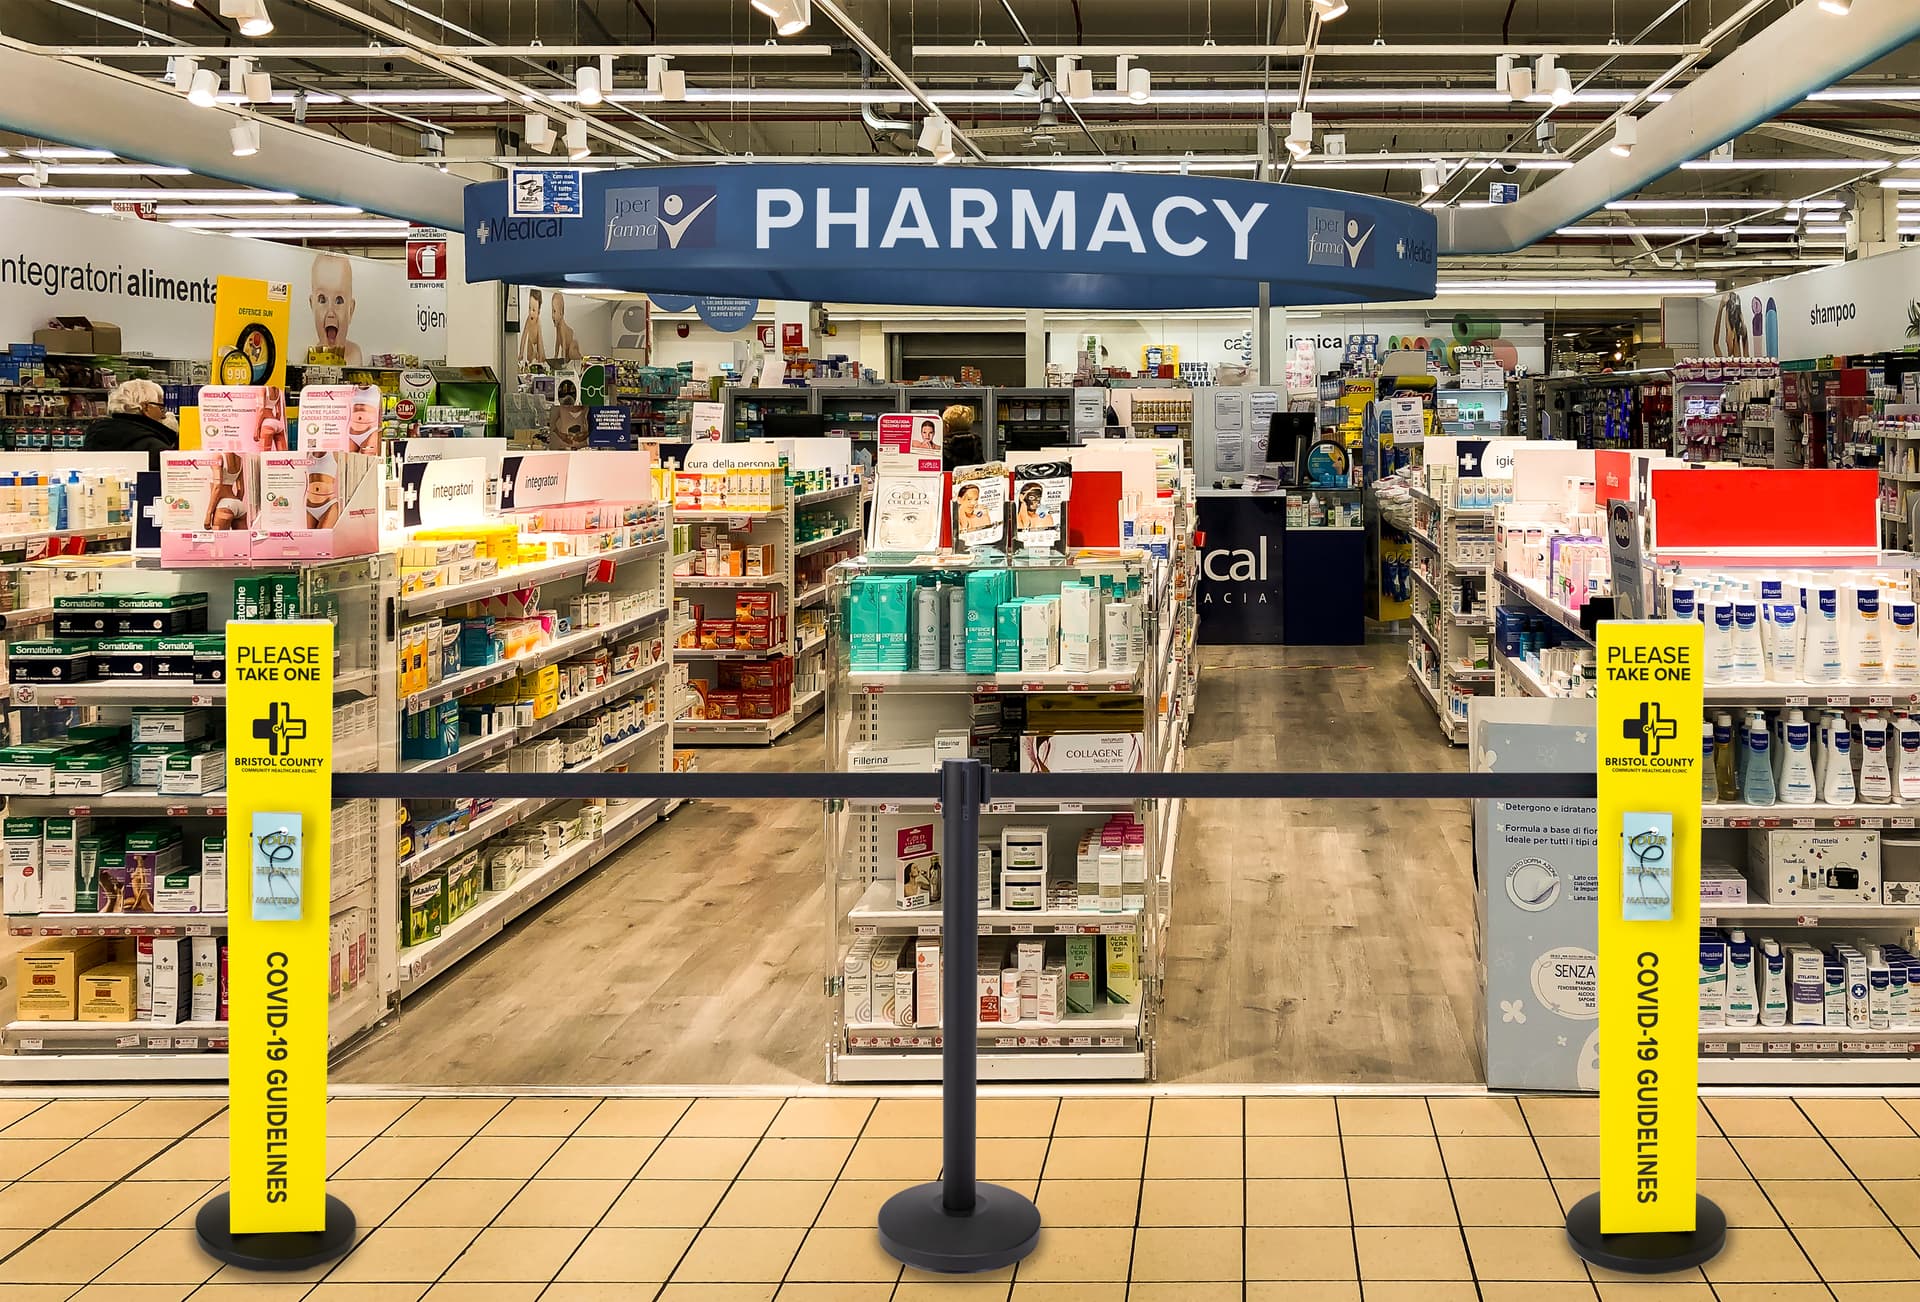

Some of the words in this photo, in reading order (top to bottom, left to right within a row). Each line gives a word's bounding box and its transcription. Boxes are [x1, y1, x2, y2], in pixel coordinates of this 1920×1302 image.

[616, 197, 650, 217] Iper
[490, 216, 564, 243] Medical
[756, 187, 1269, 261] PHARMACY
[1314, 217, 1338, 237] Iper
[604, 215, 657, 251] farma
[1307, 231, 1344, 265] farma
[1404, 238, 1433, 264] Medical
[238, 308, 262, 316] DEFENCE
[417, 304, 447, 332] igien
[1810, 302, 1856, 328] shampoo
[398, 404, 414, 412] STOP
[712, 459, 734, 468] della
[525, 472, 558, 492] integratori
[432, 480, 474, 500] integratori
[892, 492, 928, 500] GOLD
[60, 600, 104, 608] Somatoline
[118, 600, 163, 608] Somatoline
[16, 646, 62, 654] Somatoline
[98, 642, 144, 650] Somatoline
[158, 642, 194, 650] Somatoli
[238, 646, 320, 664] PLEASE
[1608, 646, 1690, 664] PLEASE
[236, 668, 278, 681] TAKE
[284, 668, 320, 681] ONE
[1607, 668, 1650, 681] TAKE
[1654, 668, 1691, 681] ONE
[854, 756, 888, 766] Fillerina
[1066, 749, 1124, 760] COLLAGENE
[234, 758, 276, 766] BRISTOL
[280, 758, 324, 767] COUNTY
[1605, 758, 1647, 766] BRISTOL
[1650, 758, 1694, 767] COUNTY
[1506, 802, 1551, 812] Detergono
[1561, 804, 1597, 814] idratano
[1506, 824, 1540, 833] Formula
[1550, 826, 1570, 834] base
[257, 836, 296, 846] YOUR
[1506, 835, 1531, 844] ideale
[1534, 838, 1548, 846] per
[1550, 838, 1568, 846] tutti
[1576, 838, 1590, 847] tipi
[1628, 836, 1667, 846] YOUR
[412, 883, 440, 897] Maalox
[906, 898, 912, 908] 3
[1554, 964, 1596, 978] SENZA
[266, 952, 288, 1062] COVID-19
[1636, 952, 1659, 1062] COVID-19
[266, 1070, 288, 1204] GUIDELINES
[1636, 1070, 1658, 1204] GUIDELINES
